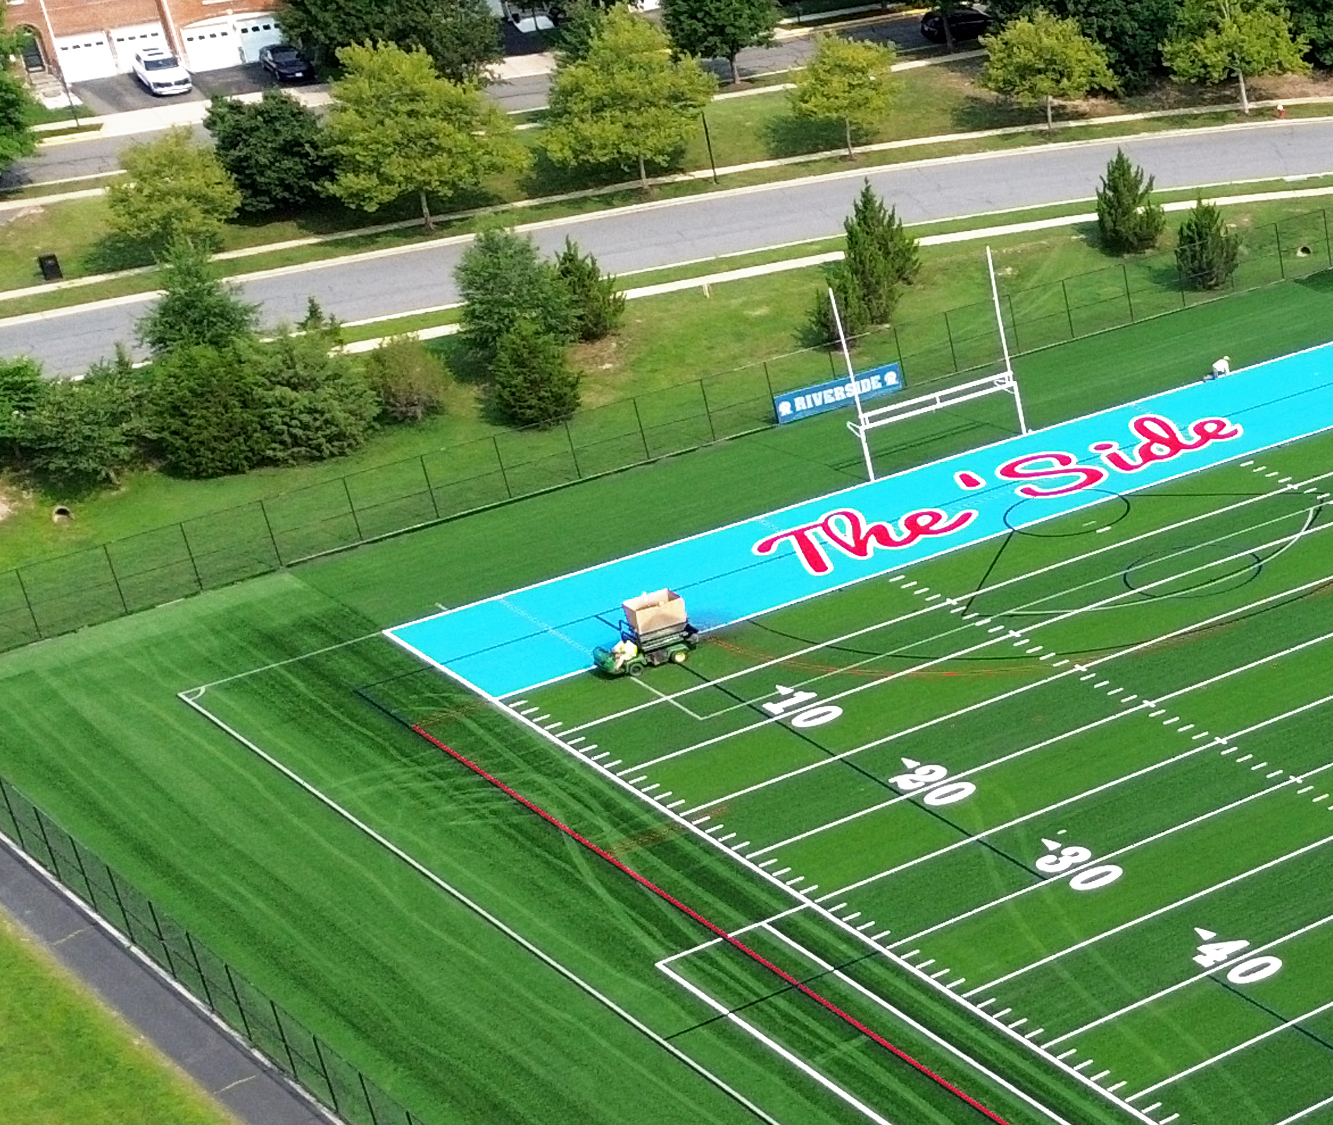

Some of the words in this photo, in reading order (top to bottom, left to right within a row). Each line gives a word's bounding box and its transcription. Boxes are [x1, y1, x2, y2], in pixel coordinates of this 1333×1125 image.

[794, 375, 882, 412] RIVERSIDE
[752, 506, 975, 576] The
[762, 690, 844, 727] 10
[889, 763, 977, 806] 20
[1034, 845, 1123, 890] 30
[1192, 937, 1283, 984] 40
